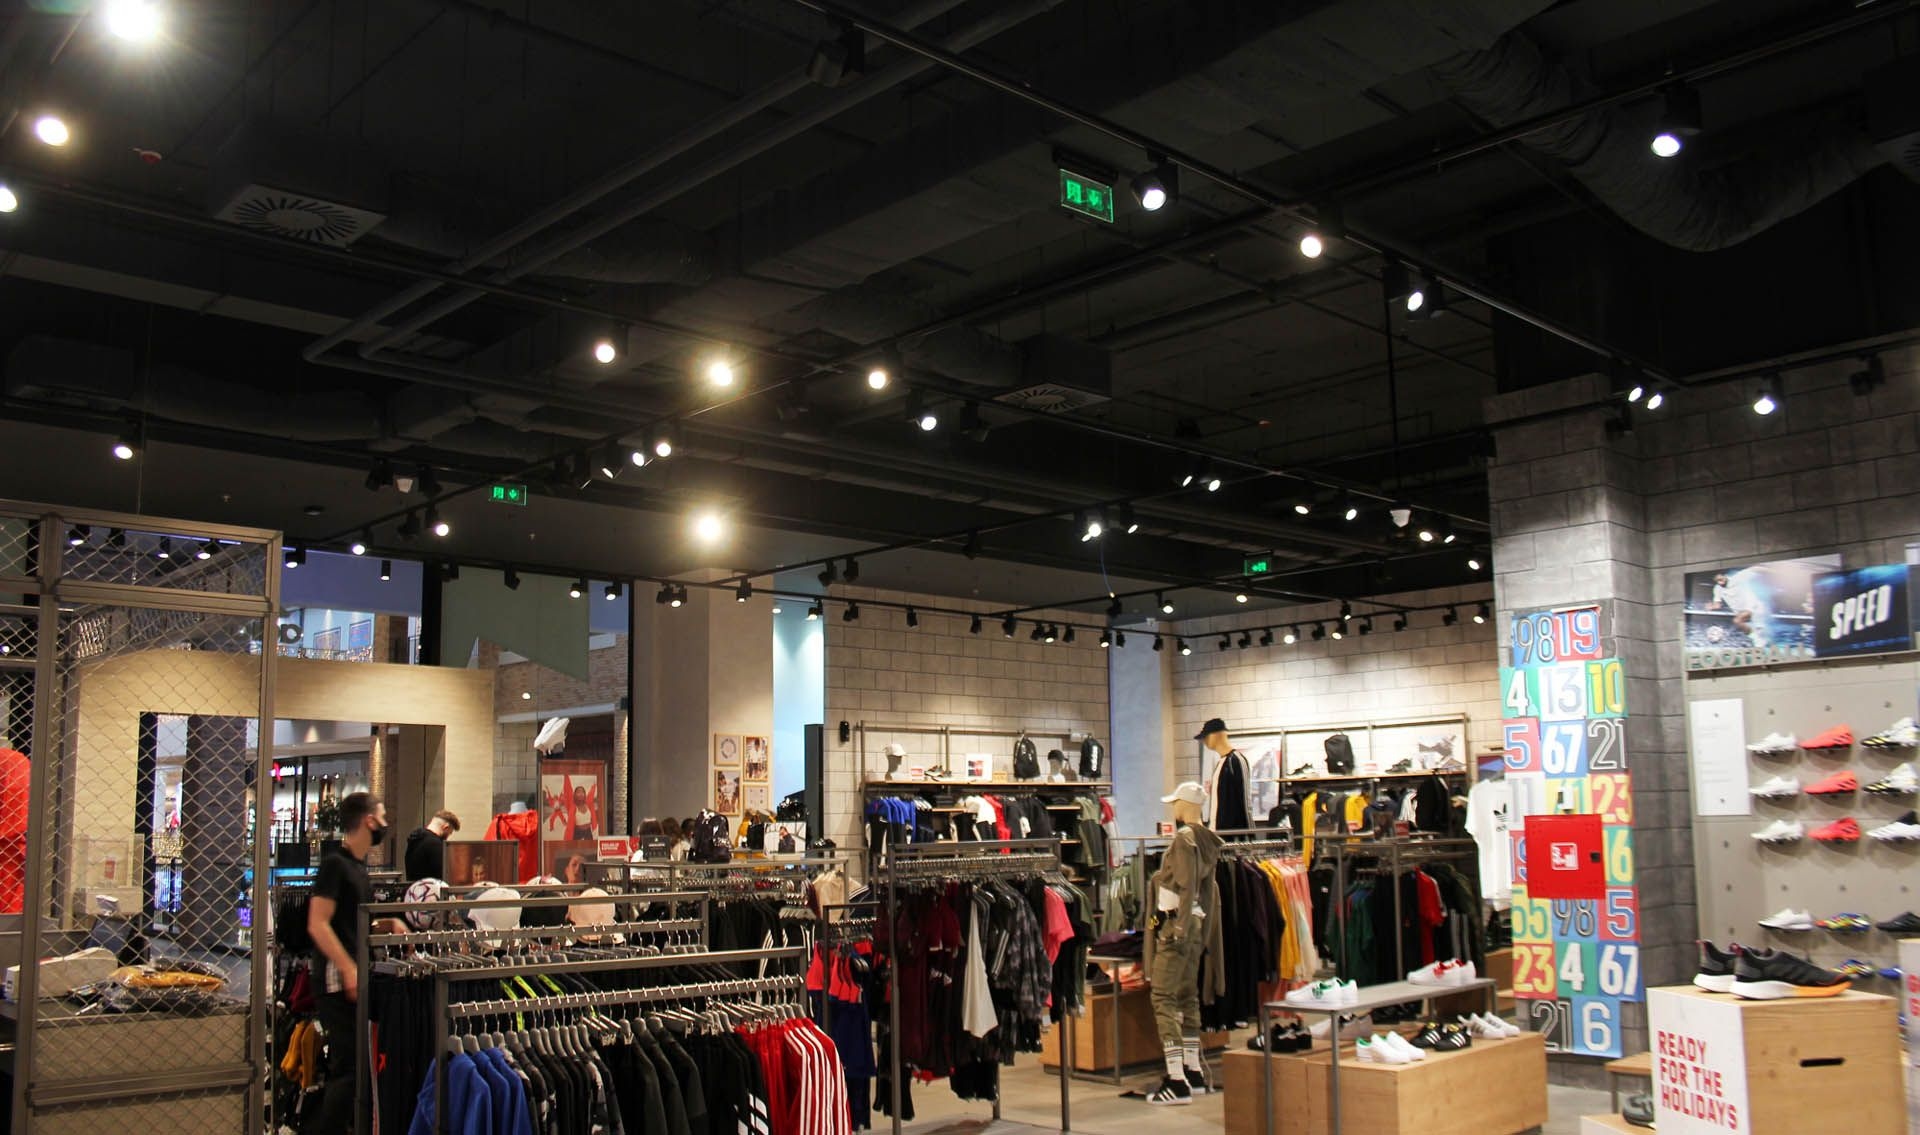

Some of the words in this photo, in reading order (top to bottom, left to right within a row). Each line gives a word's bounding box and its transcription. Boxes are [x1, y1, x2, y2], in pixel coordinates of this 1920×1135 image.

[1517, 617, 1555, 664] 98
[1556, 610, 1600, 656] 19
[1830, 584, 1892, 640] SPEED
[1687, 642, 1813, 669] FOOTBALL
[1507, 671, 1529, 717] 4
[1544, 667, 1582, 714] 13
[1589, 662, 1625, 715] 10
[1505, 724, 1530, 769] 5
[1542, 724, 1582, 774] 67
[1588, 719, 1627, 770] 21
[1593, 775, 1632, 823] 23
[1512, 888, 1548, 939] 55
[1607, 890, 1634, 937] 5
[1513, 945, 1555, 993] 23
[1560, 943, 1584, 991] 4
[1598, 945, 1639, 996] 67
[1531, 1000, 1573, 1053] 21
[1583, 1001, 1611, 1052] 6
[1658, 1031, 1706, 1064] READY
[1659, 1057, 1688, 1087] FOR
[1692, 1066, 1723, 1098] THE
[1662, 1085, 1737, 1129] HOLIDAYS
